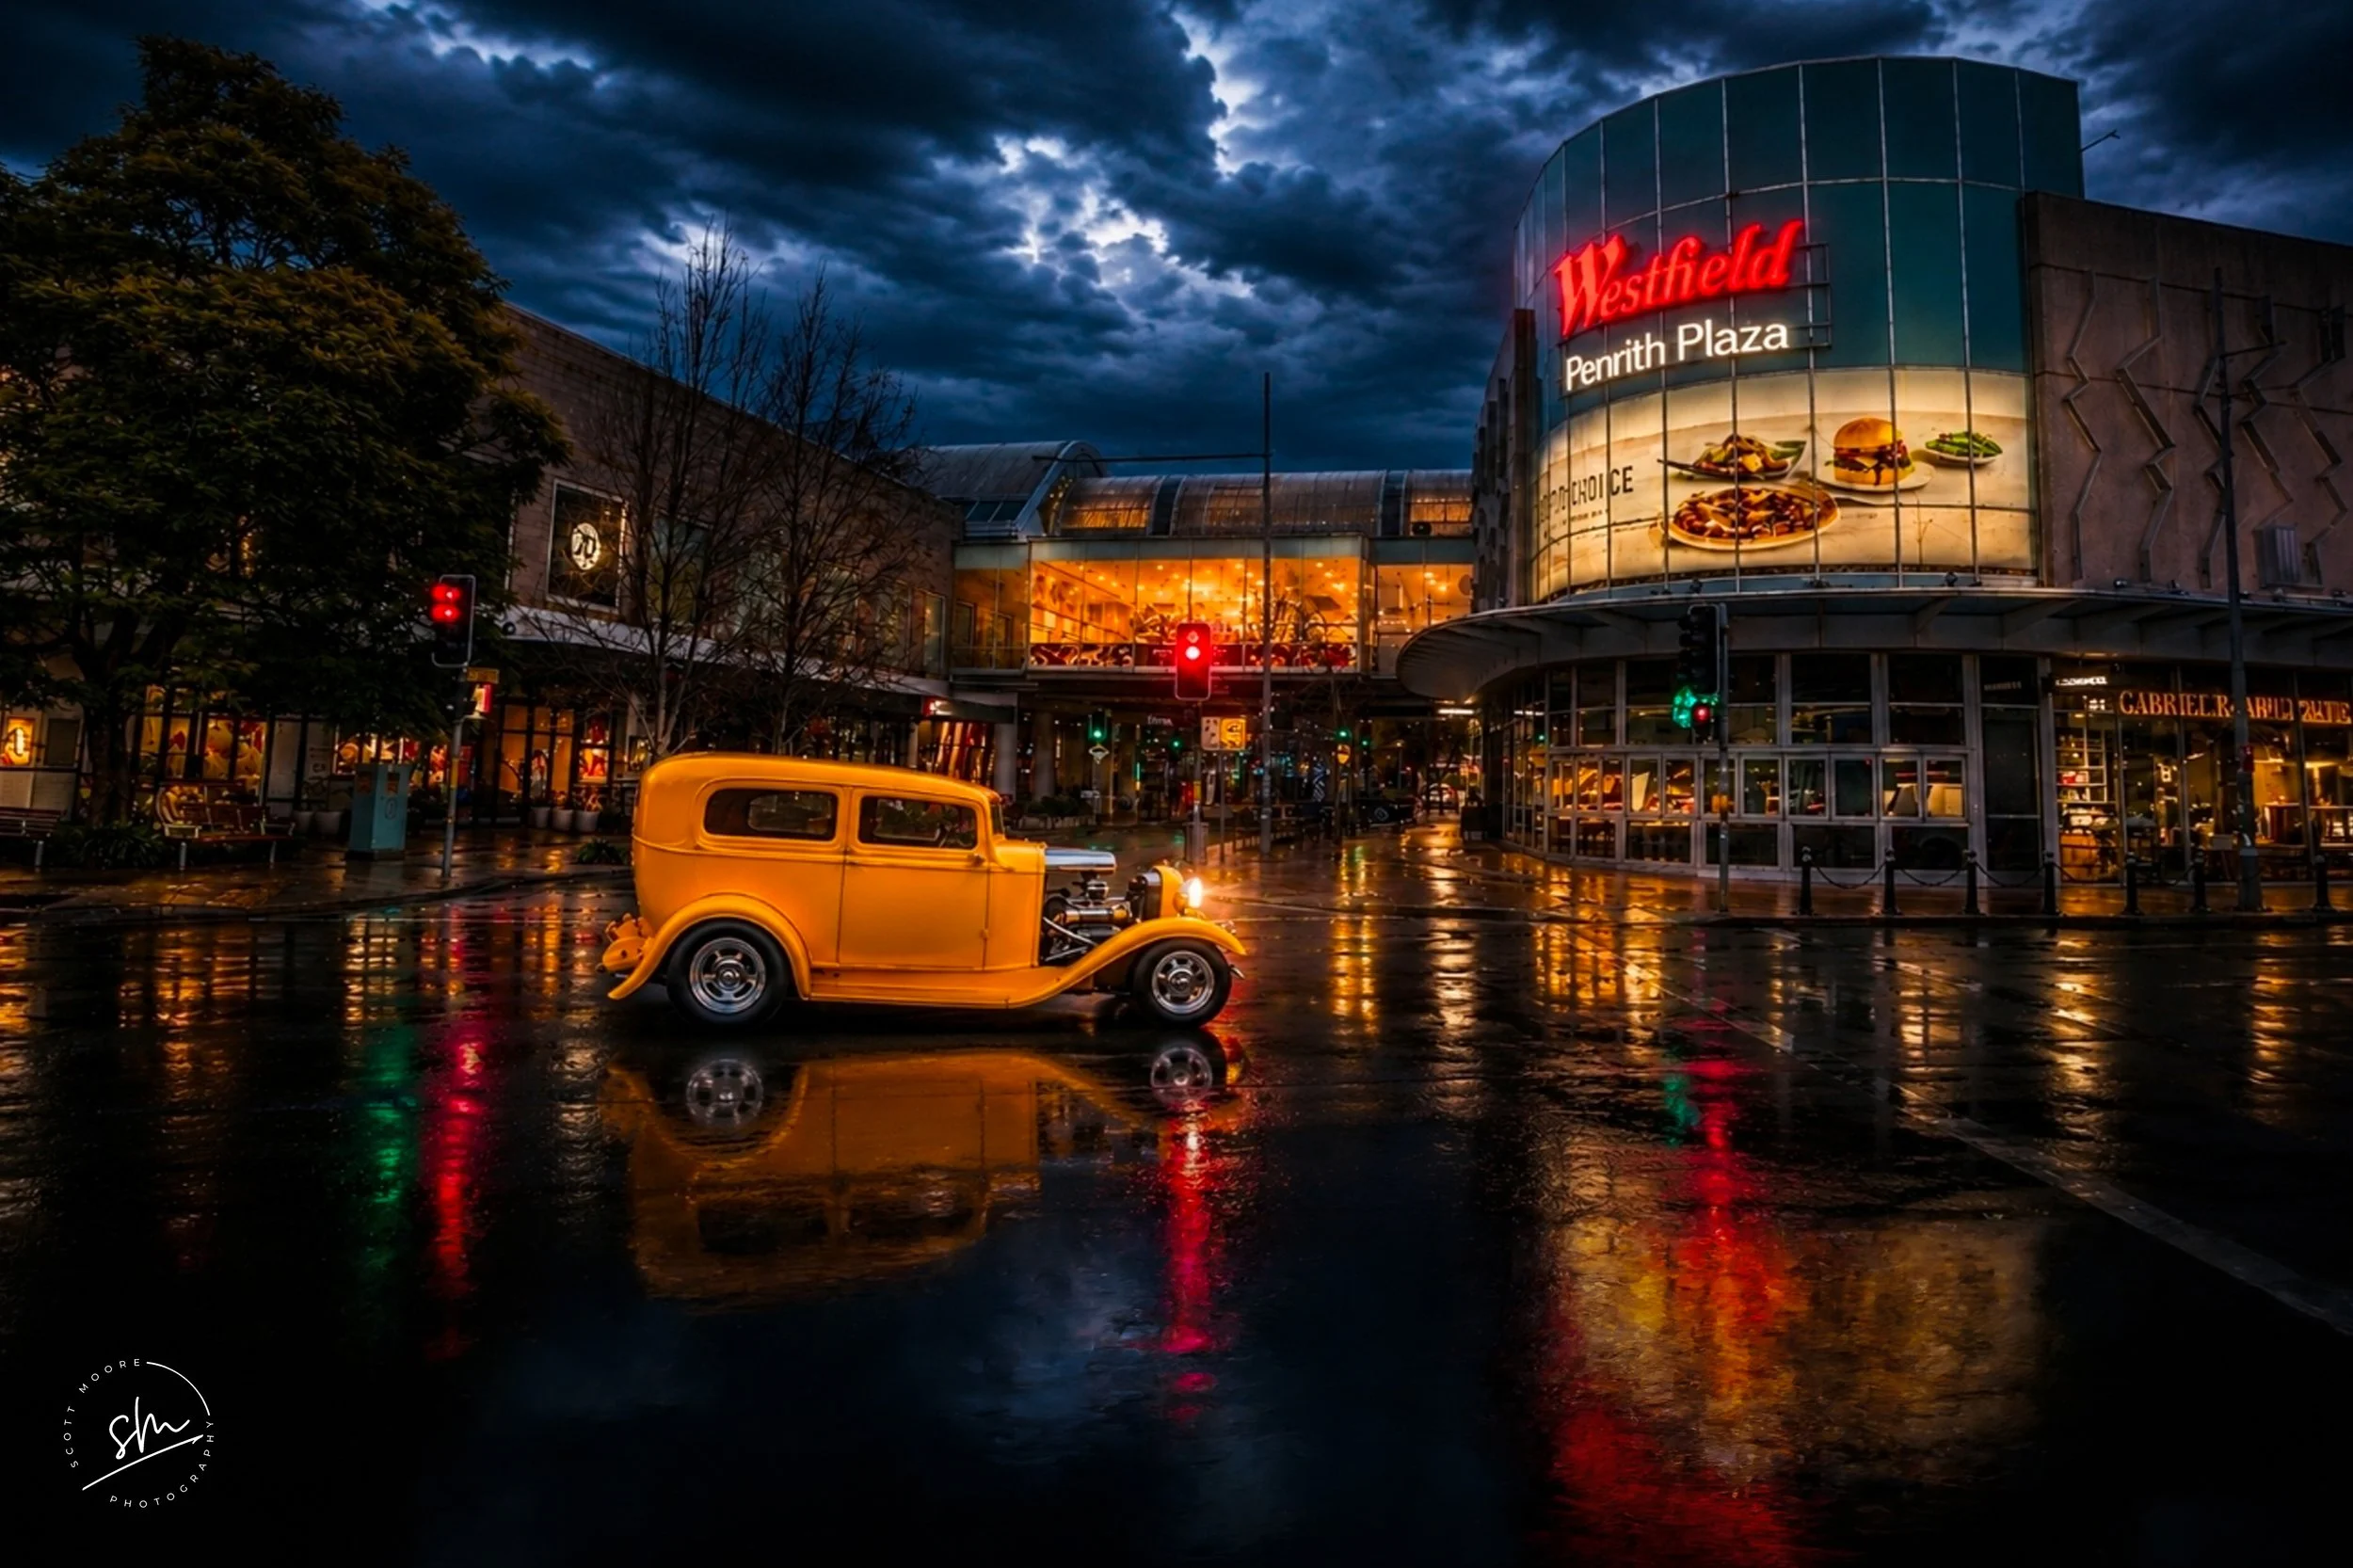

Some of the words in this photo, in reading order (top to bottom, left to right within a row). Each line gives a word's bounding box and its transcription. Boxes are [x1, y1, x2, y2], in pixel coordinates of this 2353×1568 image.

[1555, 218, 1803, 338] Westfield
[1565, 332, 1666, 392] Penrith
[1677, 319, 1788, 361] Plaza
